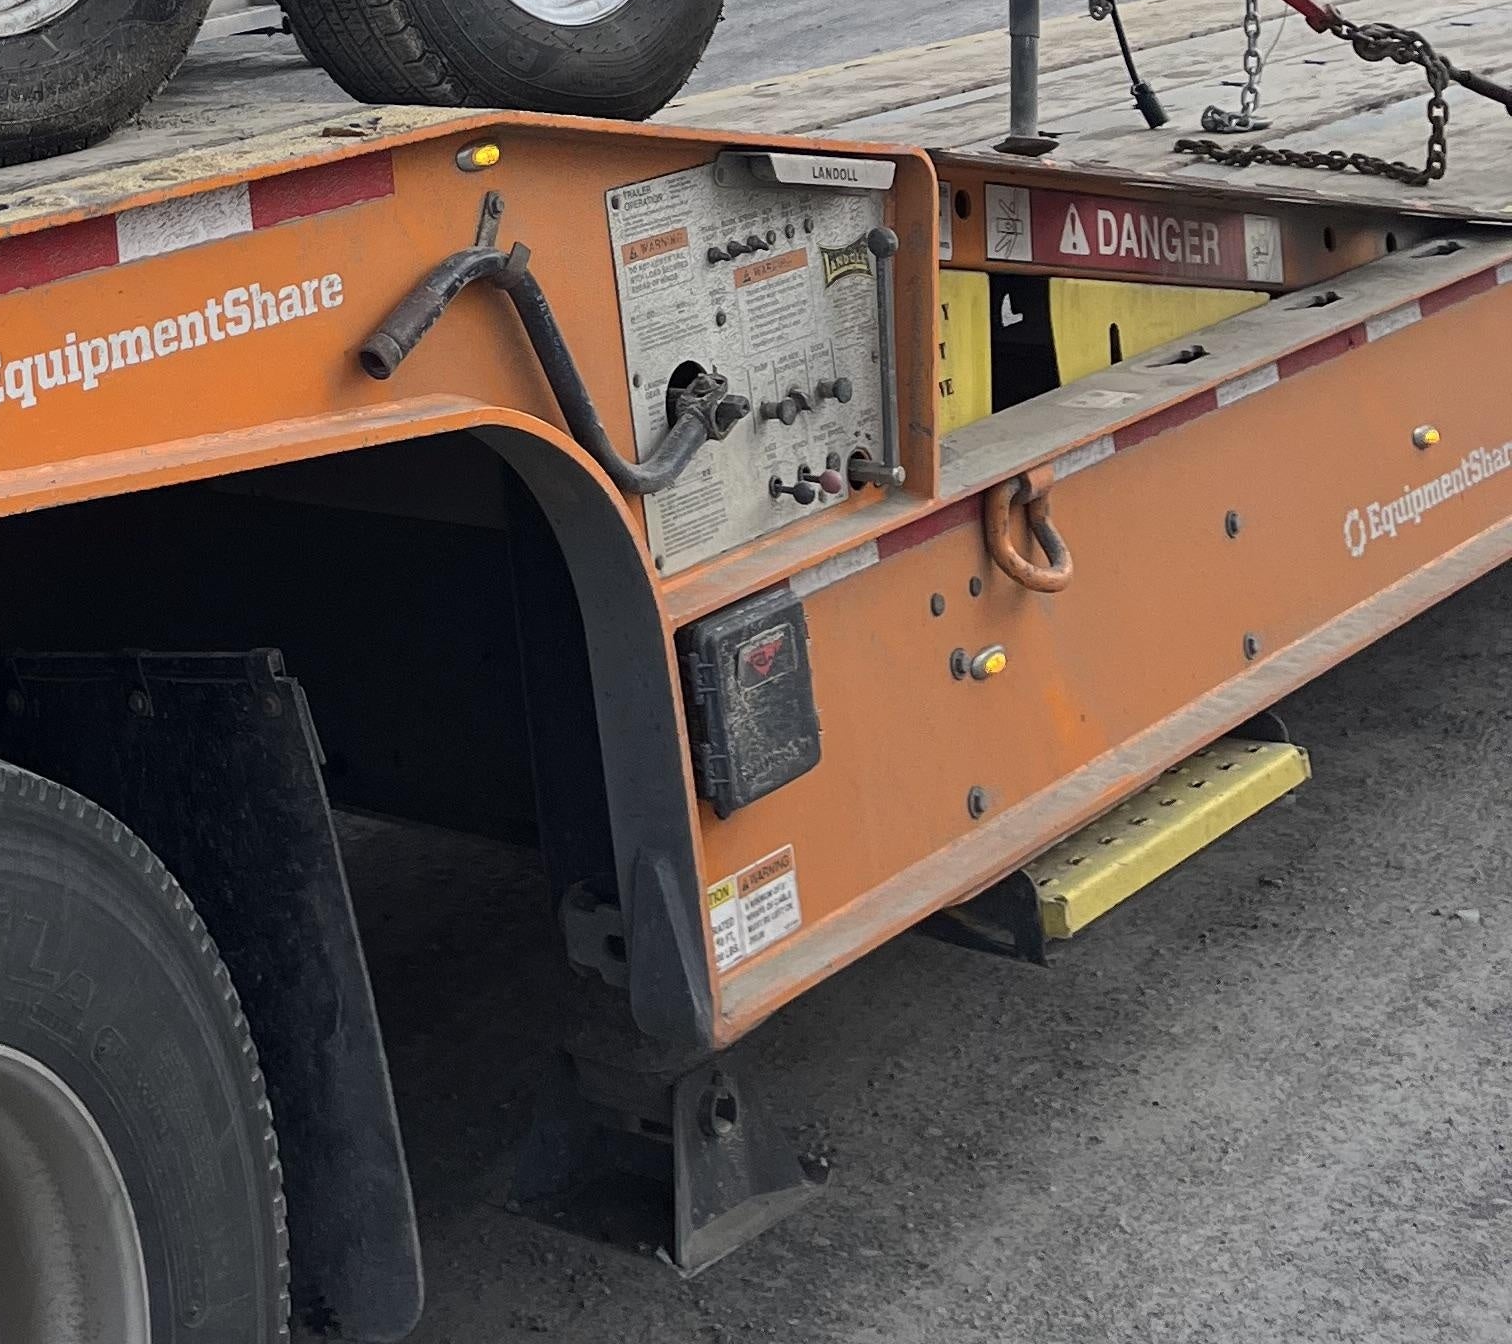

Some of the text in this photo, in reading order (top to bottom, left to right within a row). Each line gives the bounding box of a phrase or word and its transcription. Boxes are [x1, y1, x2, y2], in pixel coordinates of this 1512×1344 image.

[811, 166, 859, 182] LANDOLL
[1096, 208, 1221, 266] DANGER
[1366, 441, 1512, 540] EquipmentShar
